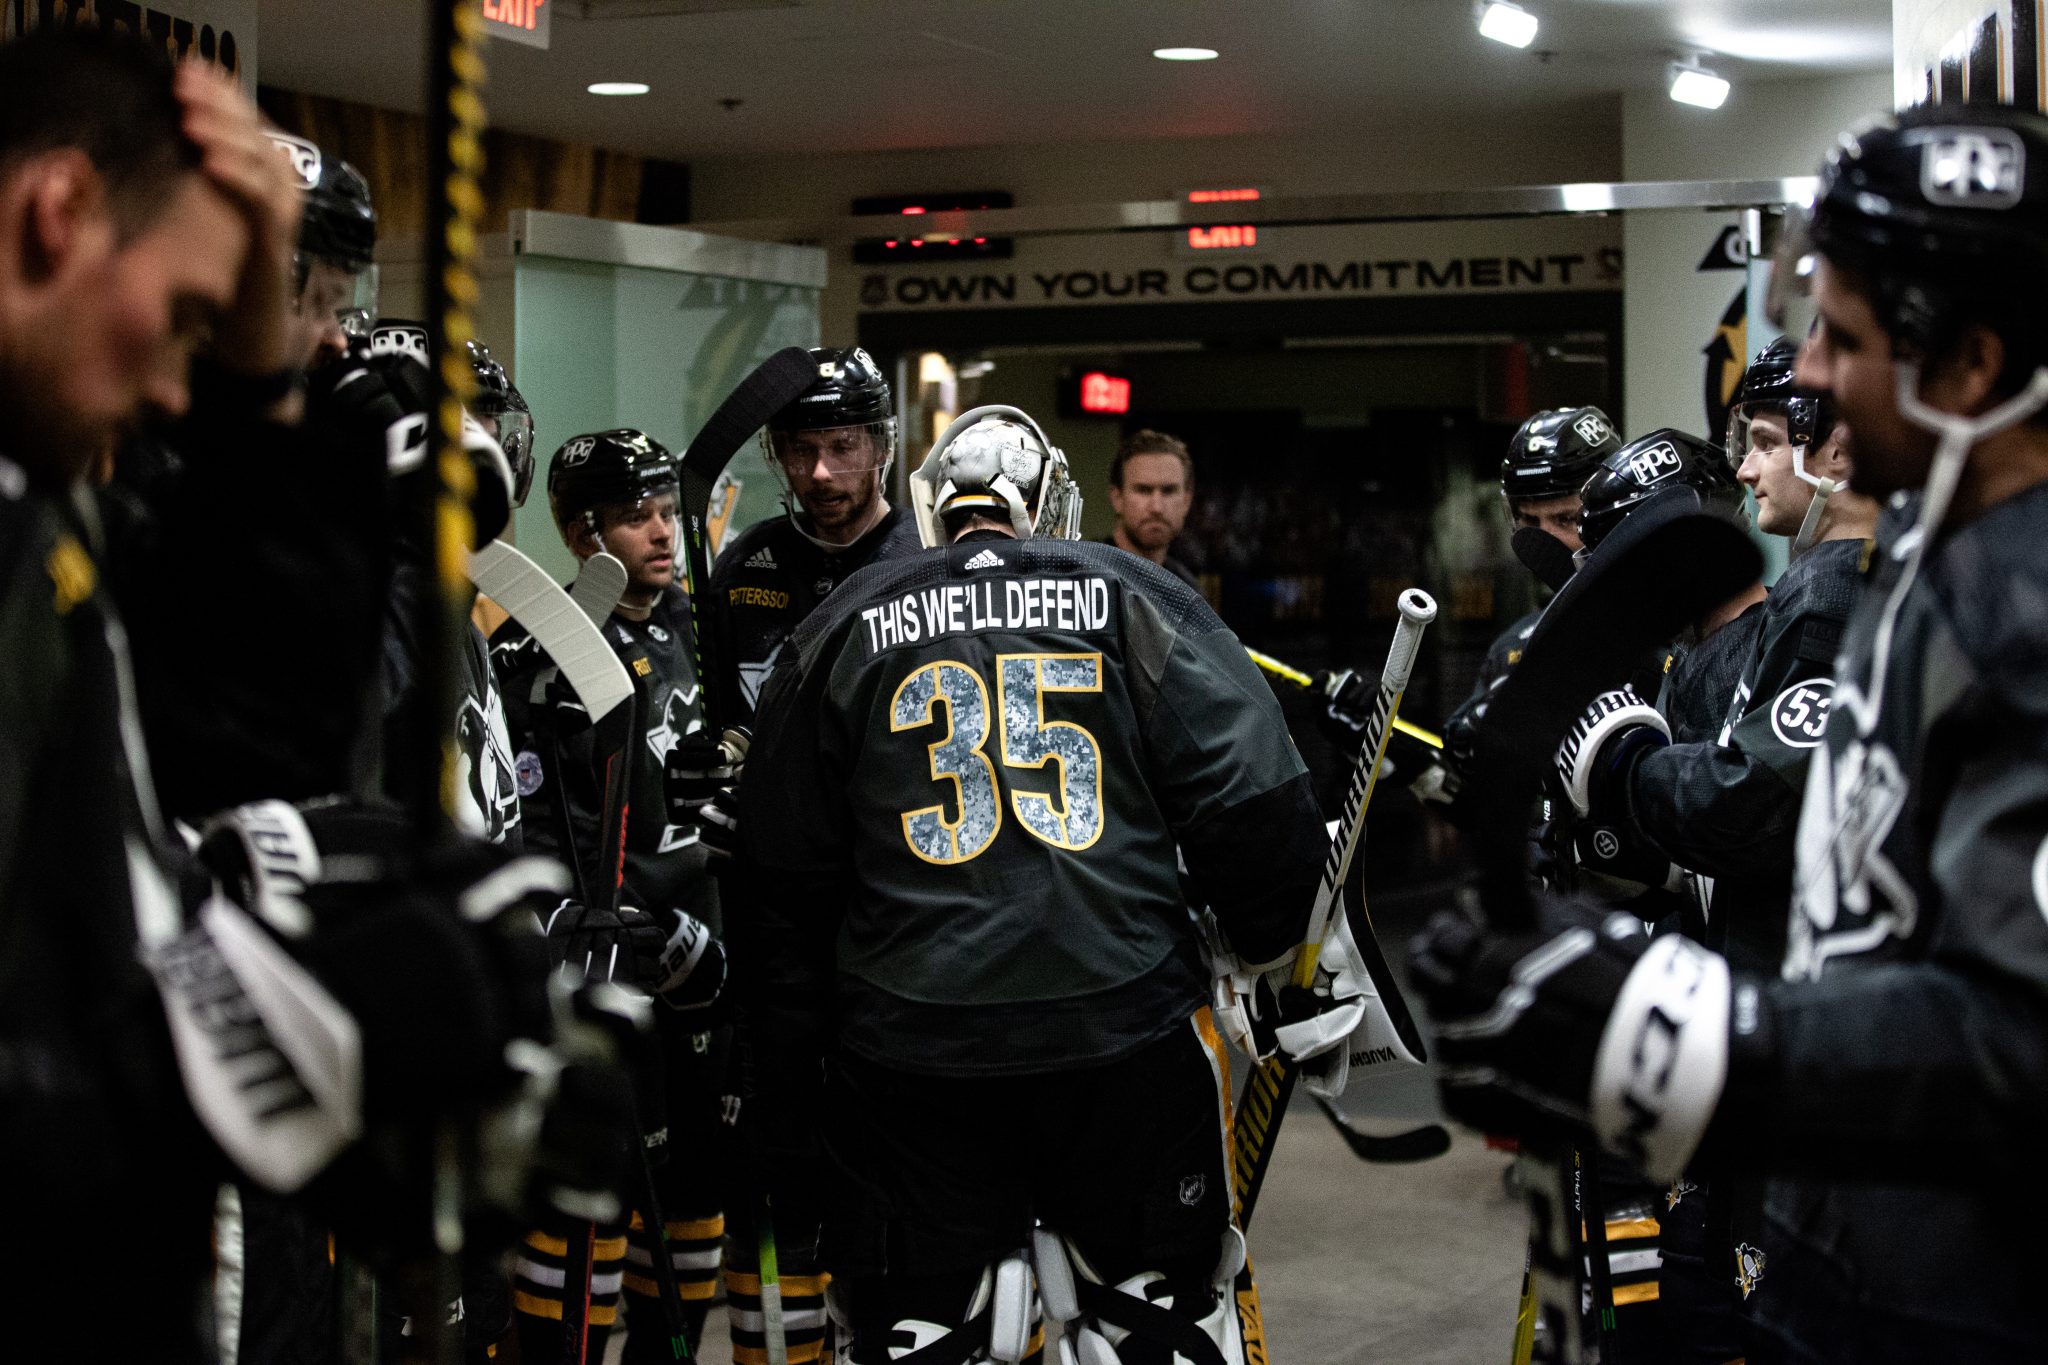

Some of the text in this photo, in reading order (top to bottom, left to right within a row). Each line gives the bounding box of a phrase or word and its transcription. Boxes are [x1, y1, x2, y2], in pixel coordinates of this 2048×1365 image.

[899, 254, 1585, 301] OWN YOUR COMMITMENT
[563, 440, 593, 464] PPG
[1634, 447, 1677, 483] PPG
[744, 559, 778, 570] adidas
[964, 558, 1005, 570] adidas
[861, 577, 1109, 654] THIS WE'LL DEFEND
[1780, 687, 1833, 737] 53
[889, 651, 1105, 866] 35
